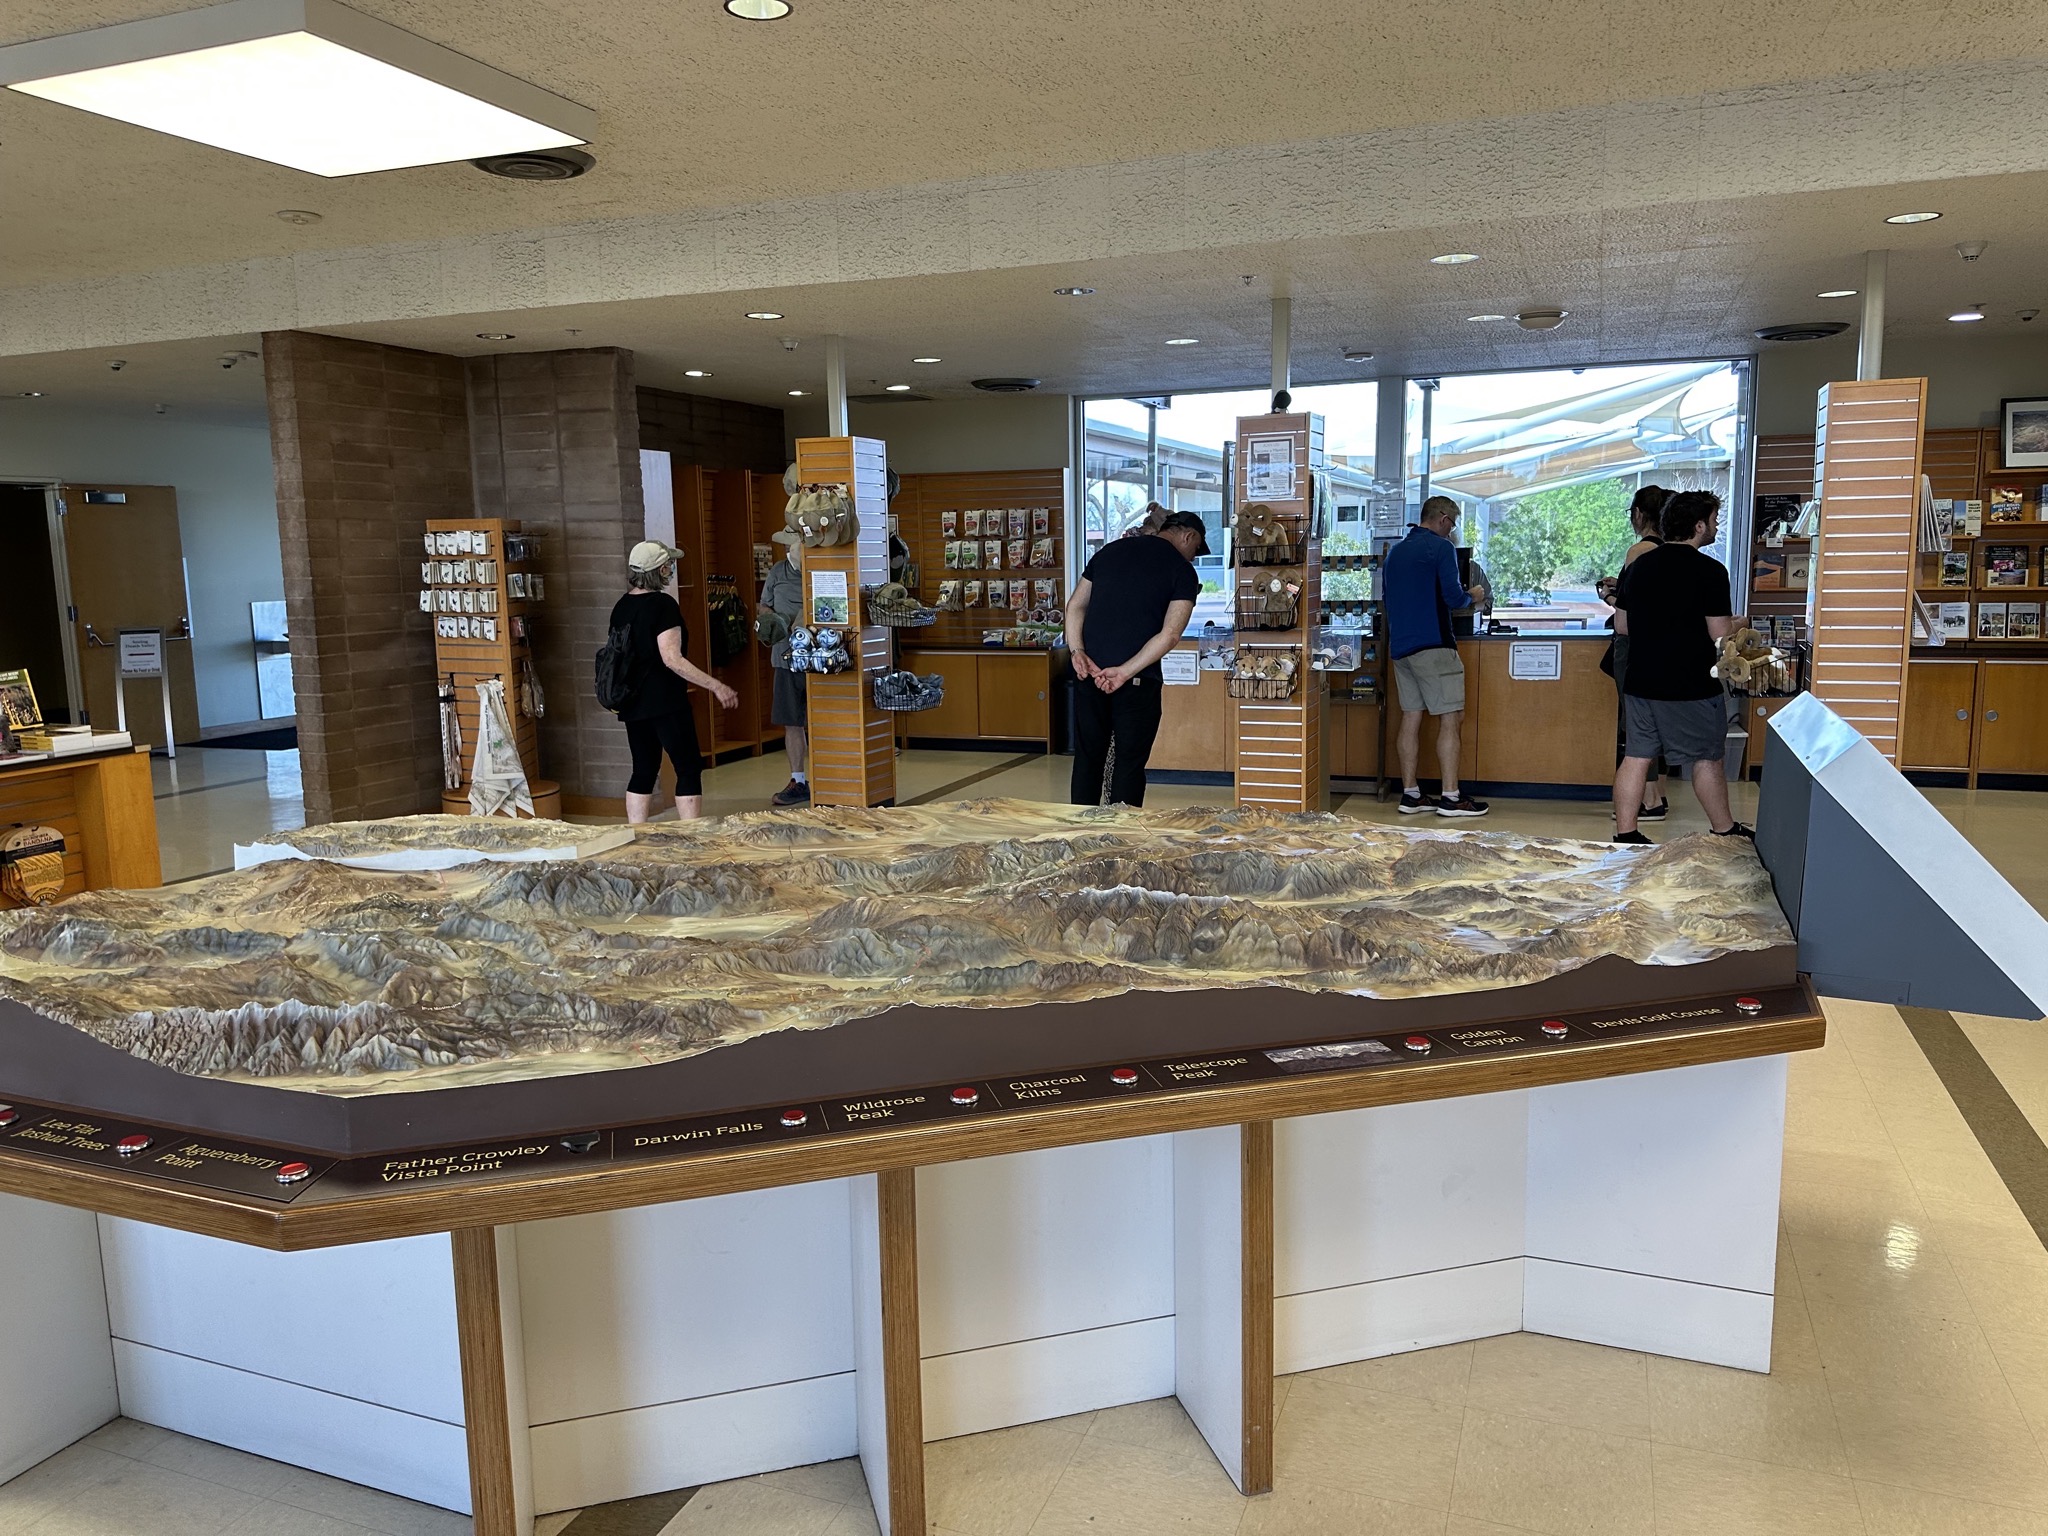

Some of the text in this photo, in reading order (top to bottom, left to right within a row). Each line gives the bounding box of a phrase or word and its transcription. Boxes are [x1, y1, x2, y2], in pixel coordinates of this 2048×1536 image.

[1592, 1006, 1724, 1029] Devils Golf Course
[1450, 1026, 1506, 1042] Golden
[1462, 1033, 1525, 1049] Canyon
[1163, 1055, 1249, 1073] Telescope
[1009, 1074, 1088, 1091] Charcoal
[1172, 1068, 1218, 1081] Peak
[1015, 1087, 1062, 1100] Kilns
[843, 1094, 927, 1112] Wildrose
[846, 1108, 895, 1122] Peak
[40, 1118, 103, 1136] Lee Flat
[634, 1121, 764, 1147] Darwin Falls
[10, 1127, 111, 1152] Joshua Trees
[155, 1152, 203, 1170] Point
[178, 1143, 283, 1170] Aguereberry
[383, 1143, 551, 1172] Father Crowley
[381, 1159, 504, 1182] Vista Point
